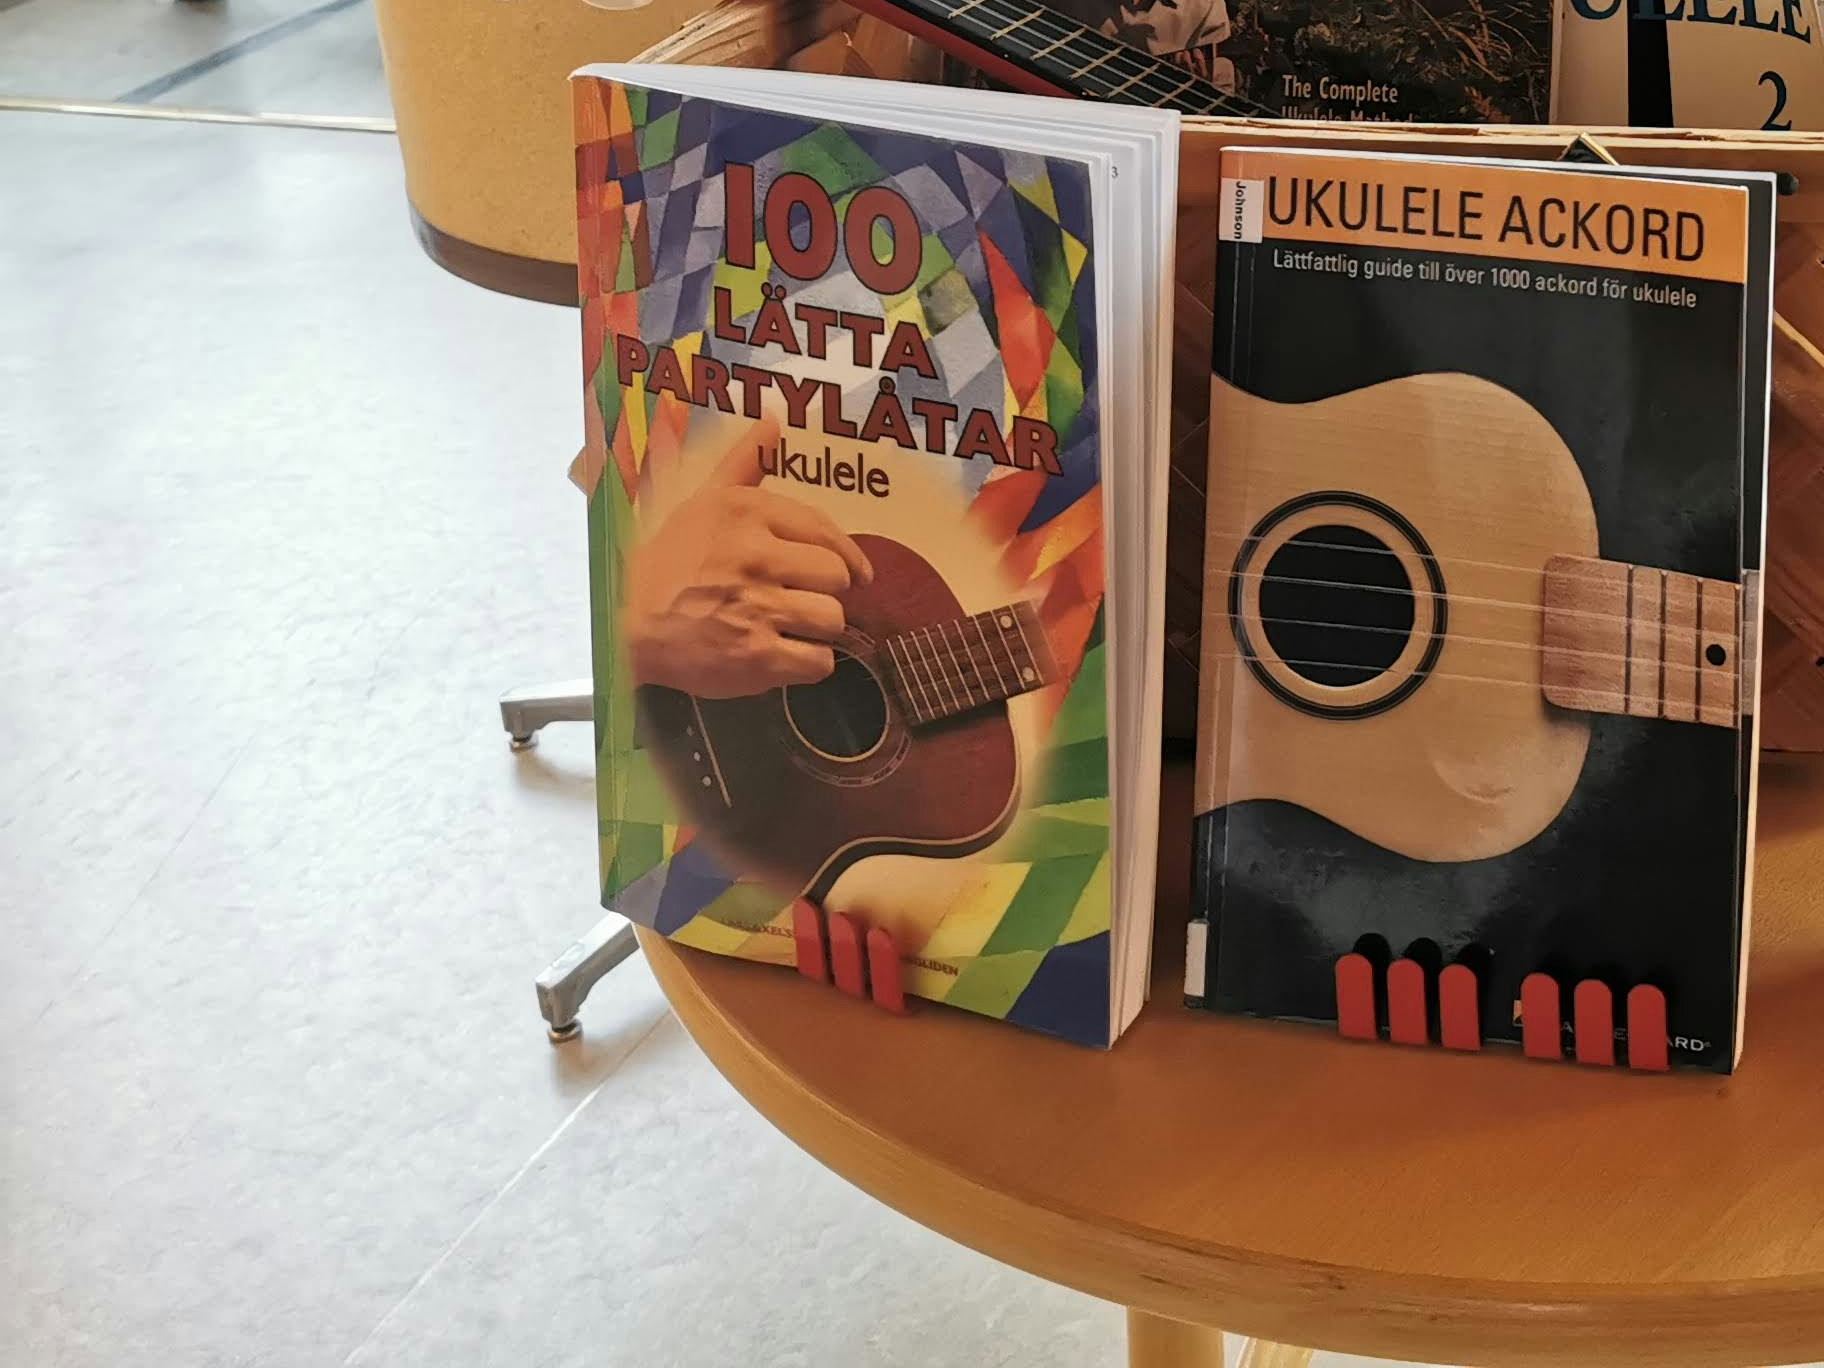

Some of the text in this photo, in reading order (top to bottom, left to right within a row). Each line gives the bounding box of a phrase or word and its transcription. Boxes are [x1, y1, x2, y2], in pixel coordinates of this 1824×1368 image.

[1282, 74, 1399, 107] The Complete
[1758, 70, 1793, 131] 2
[723, 161, 923, 296] 100
[1234, 181, 1246, 241] Johnson
[1268, 175, 1706, 264] UKULELE ACKORD
[1273, 248, 1697, 309] Lättfattlig guide till över 1000 ackord för ukulele
[713, 281, 938, 380] LÄTTA
[617, 332, 1064, 477] PARTYLÅTAR
[757, 436, 890, 499] ukulele
